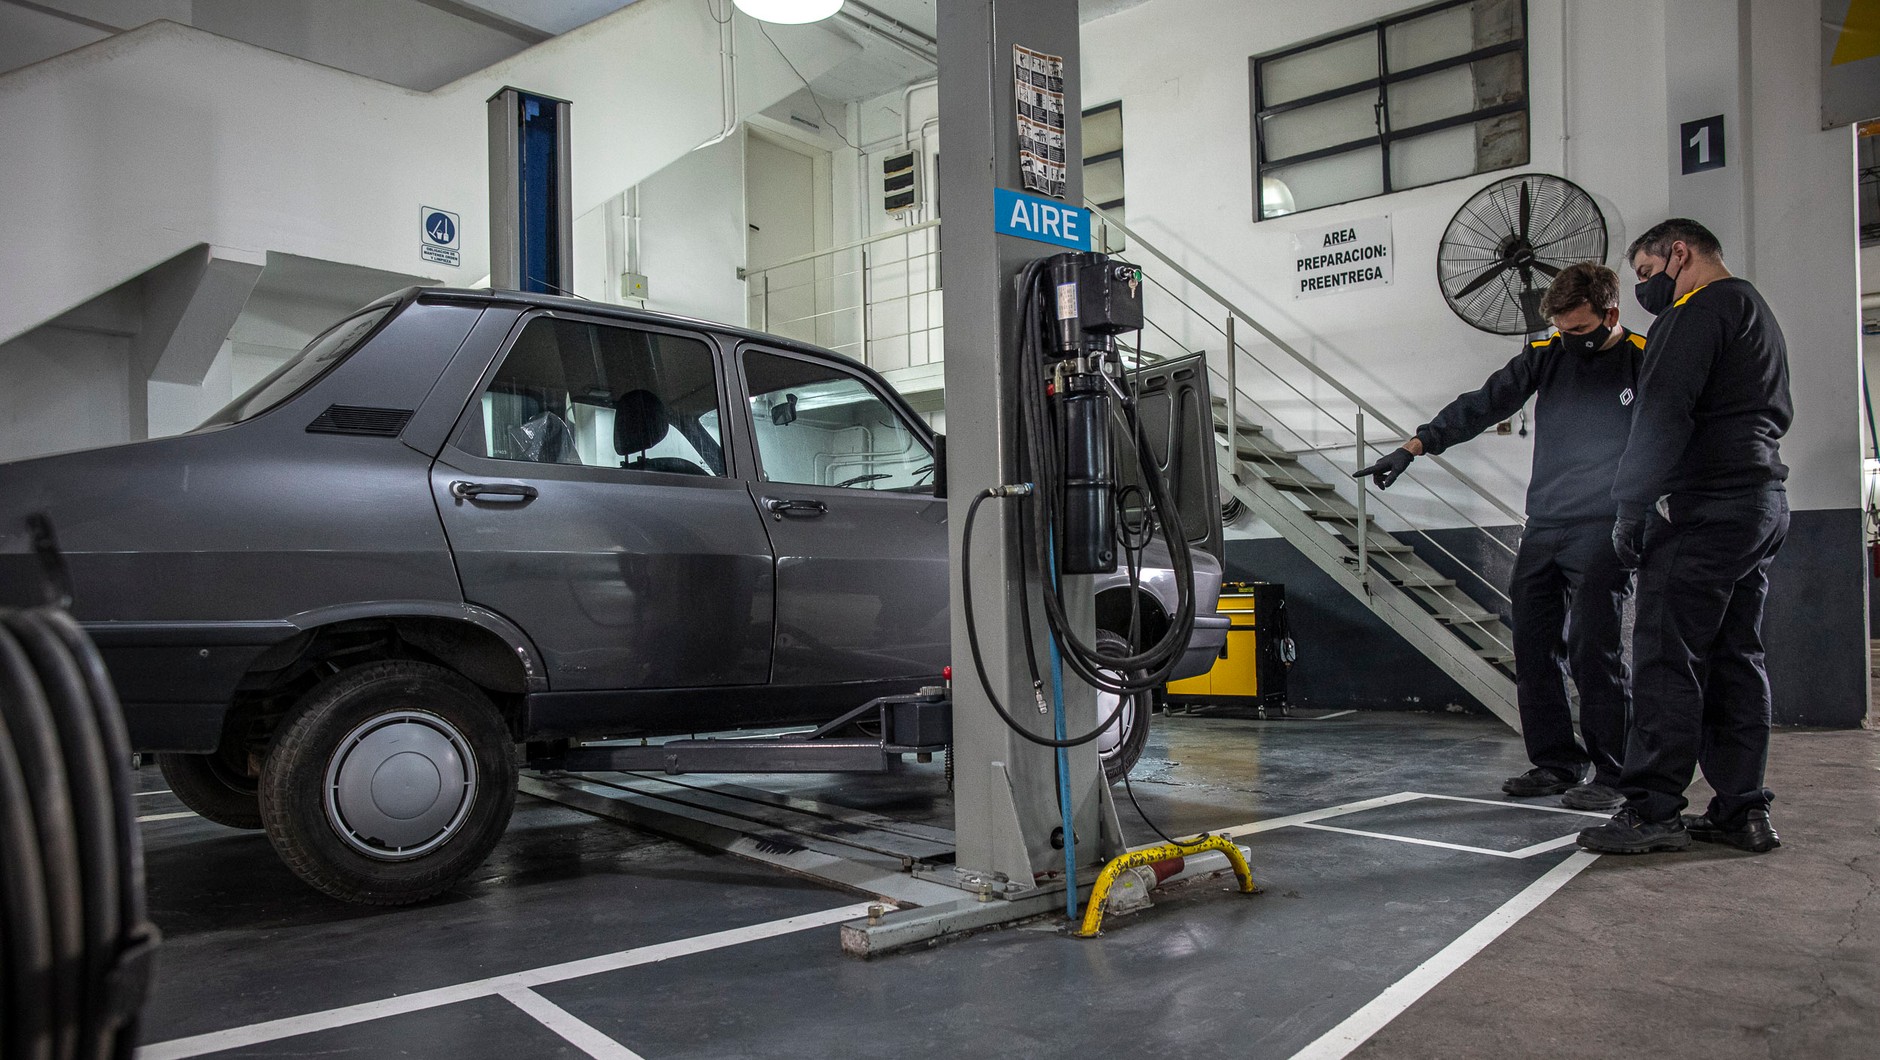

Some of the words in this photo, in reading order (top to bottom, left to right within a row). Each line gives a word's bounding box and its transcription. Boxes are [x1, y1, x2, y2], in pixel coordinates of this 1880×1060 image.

[1689, 126, 1710, 164] 1
[1010, 198, 1079, 241] AIRE
[1323, 228, 1357, 247] AREA
[1297, 244, 1387, 272] PREPARACION:
[1300, 266, 1383, 292] PREENTREGA
